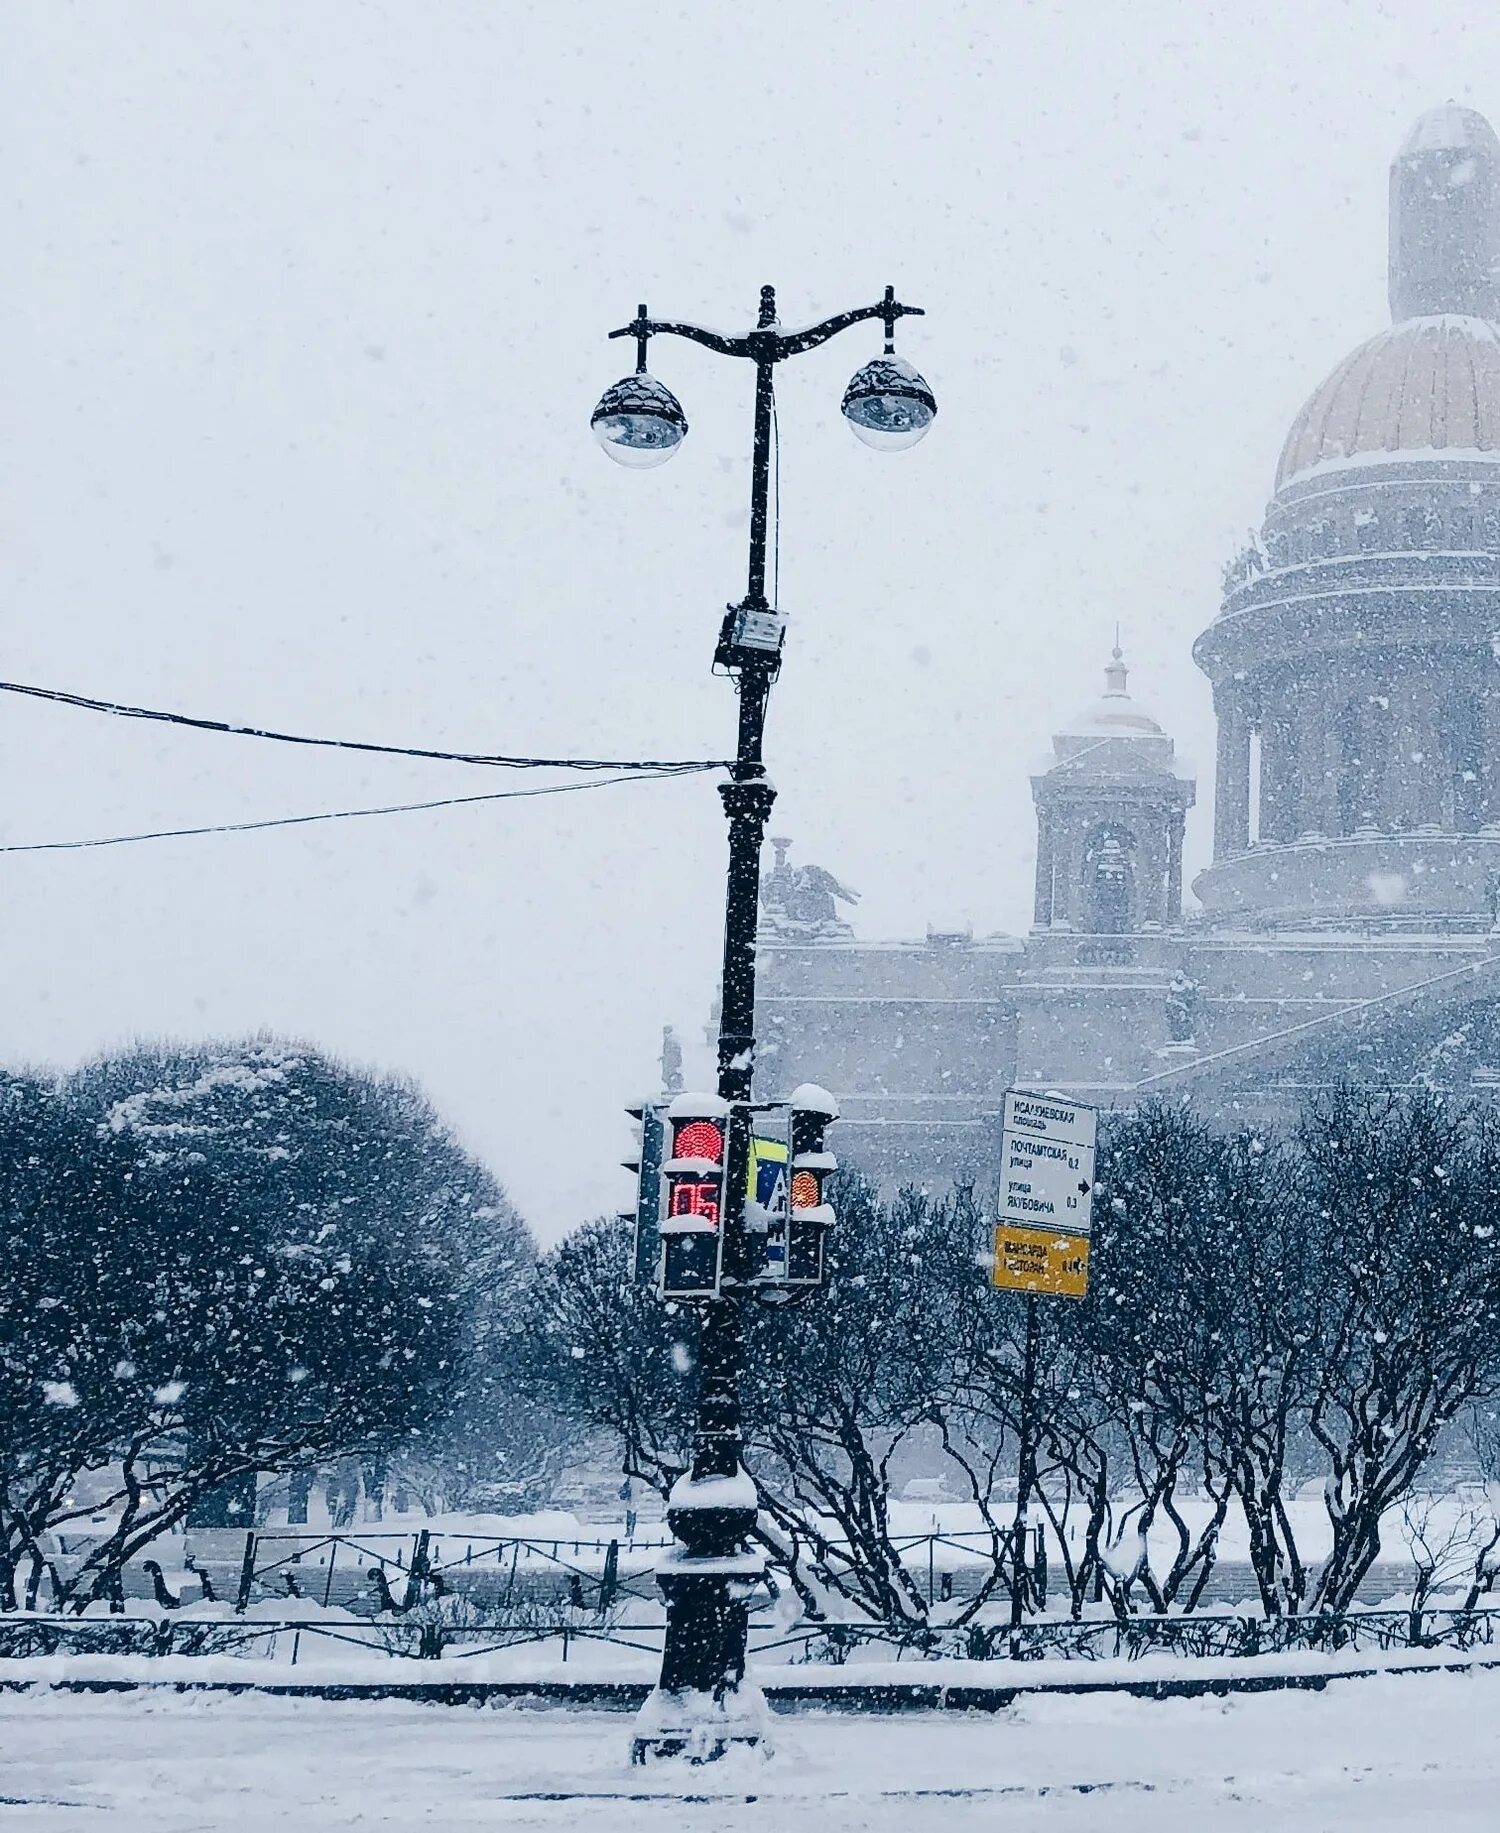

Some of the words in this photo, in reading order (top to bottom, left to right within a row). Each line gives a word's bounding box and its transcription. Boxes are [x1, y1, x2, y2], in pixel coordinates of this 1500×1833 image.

[1010, 1140, 1068, 1161] ПОЧТАМТСКАЯ
[1009, 1156, 1033, 1170] улица
[1008, 1181, 1032, 1194] улица
[1007, 1196, 1054, 1214] ЯКУБОВИЧА
